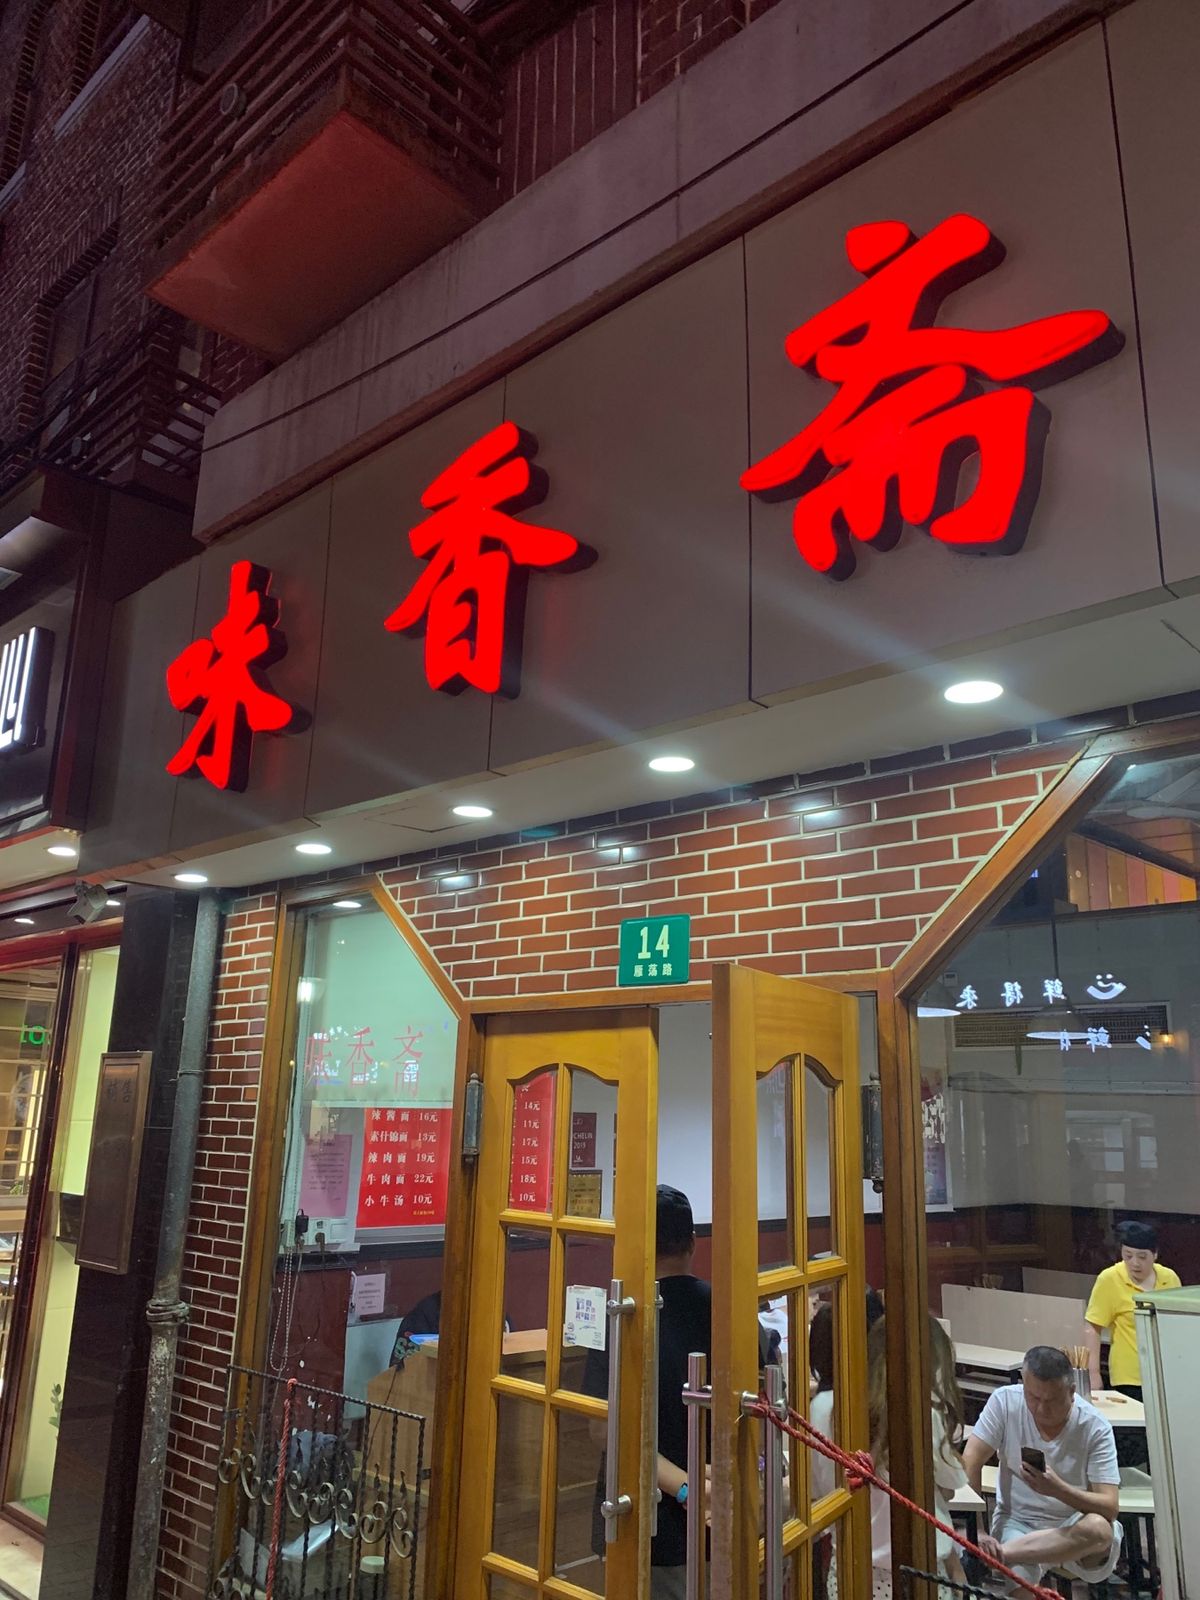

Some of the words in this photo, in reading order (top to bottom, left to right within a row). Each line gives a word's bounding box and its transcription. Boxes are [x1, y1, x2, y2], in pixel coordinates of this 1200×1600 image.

[165, 213, 1114, 791] 味香斋
[637, 924, 670, 960] 14
[366, 1173, 406, 1185] 牛肉面
[414, 1172, 434, 1184] 22元
[364, 1194, 405, 1207] 小牛汤
[413, 1193, 433, 1205] 10元
